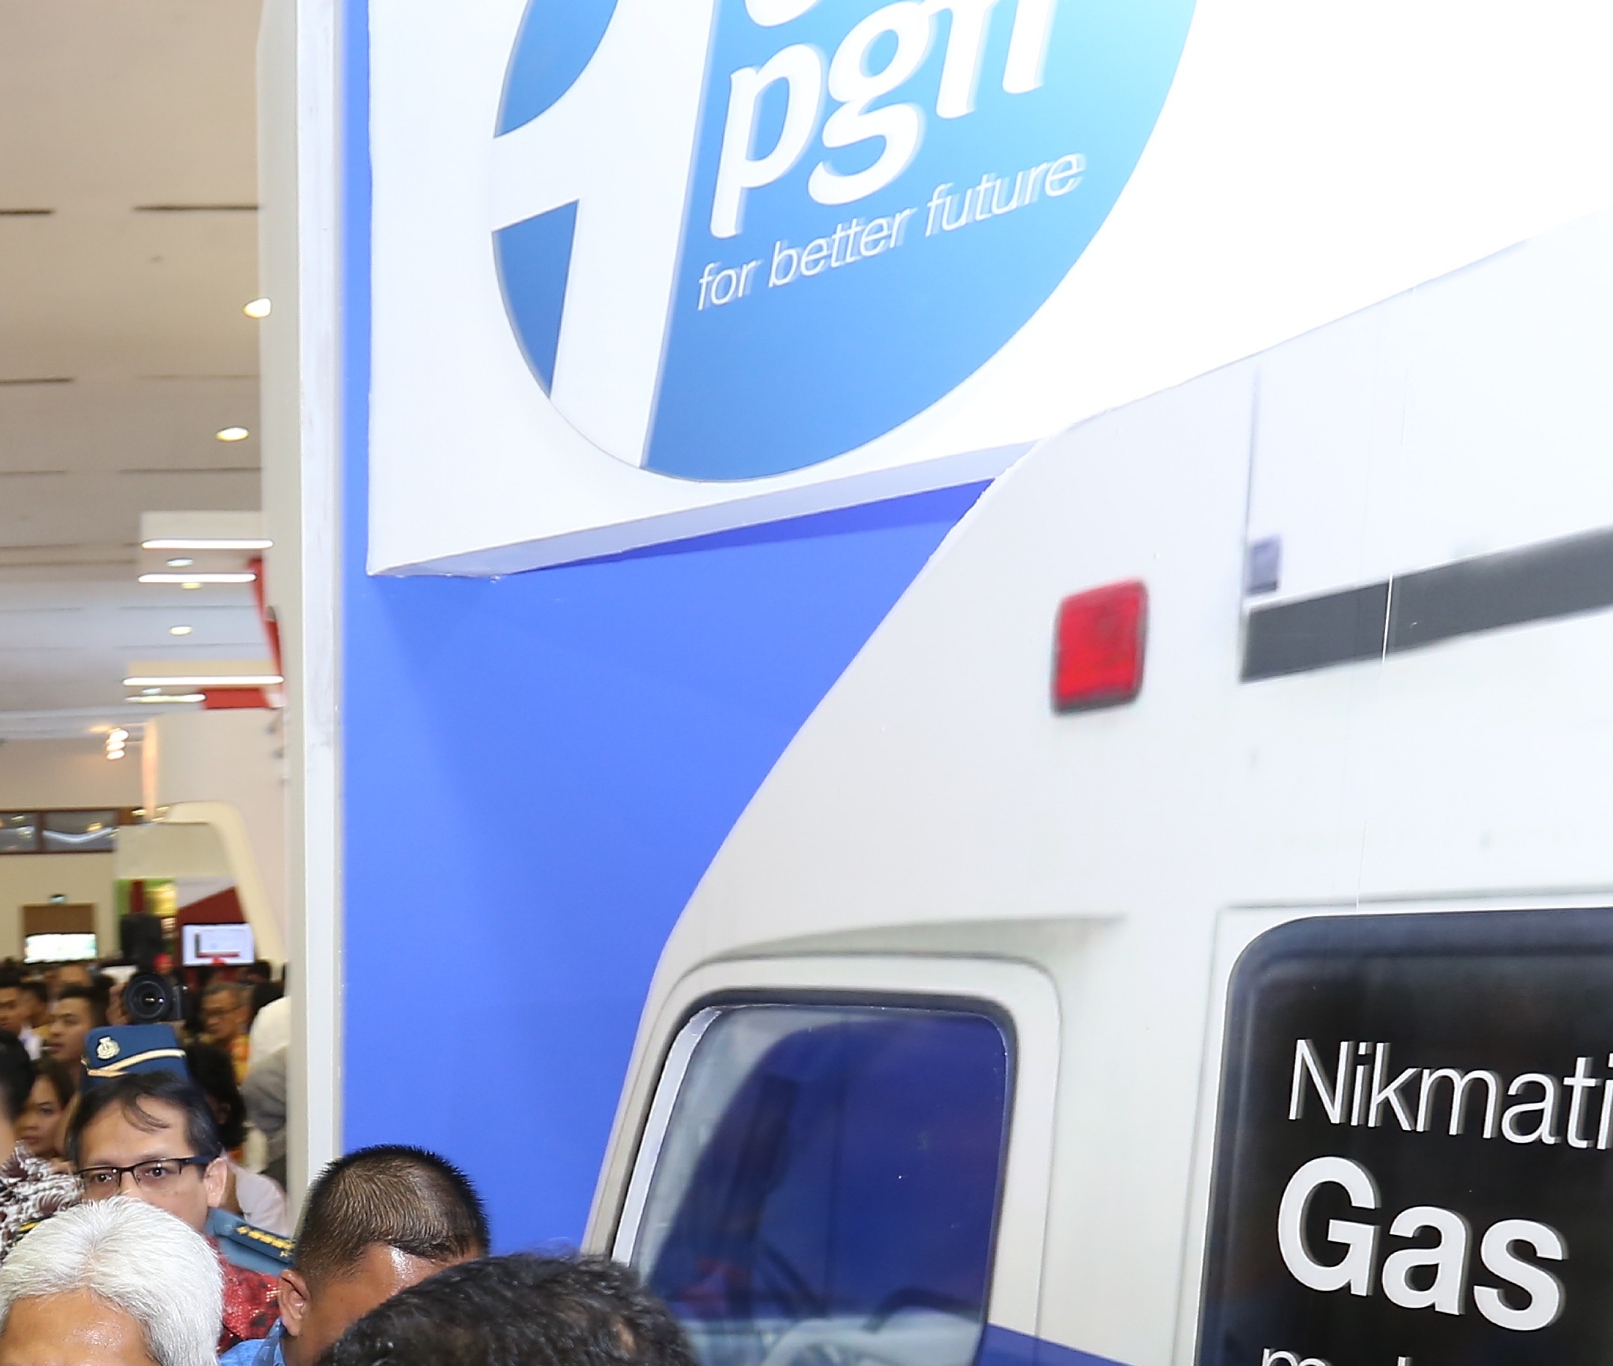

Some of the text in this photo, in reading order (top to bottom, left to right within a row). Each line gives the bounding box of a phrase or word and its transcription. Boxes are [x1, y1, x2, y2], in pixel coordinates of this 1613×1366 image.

[697, 152, 1086, 310] for better future
[1289, 1038, 1613, 1151] Nikmati
[1277, 1156, 1568, 1331] Gas
